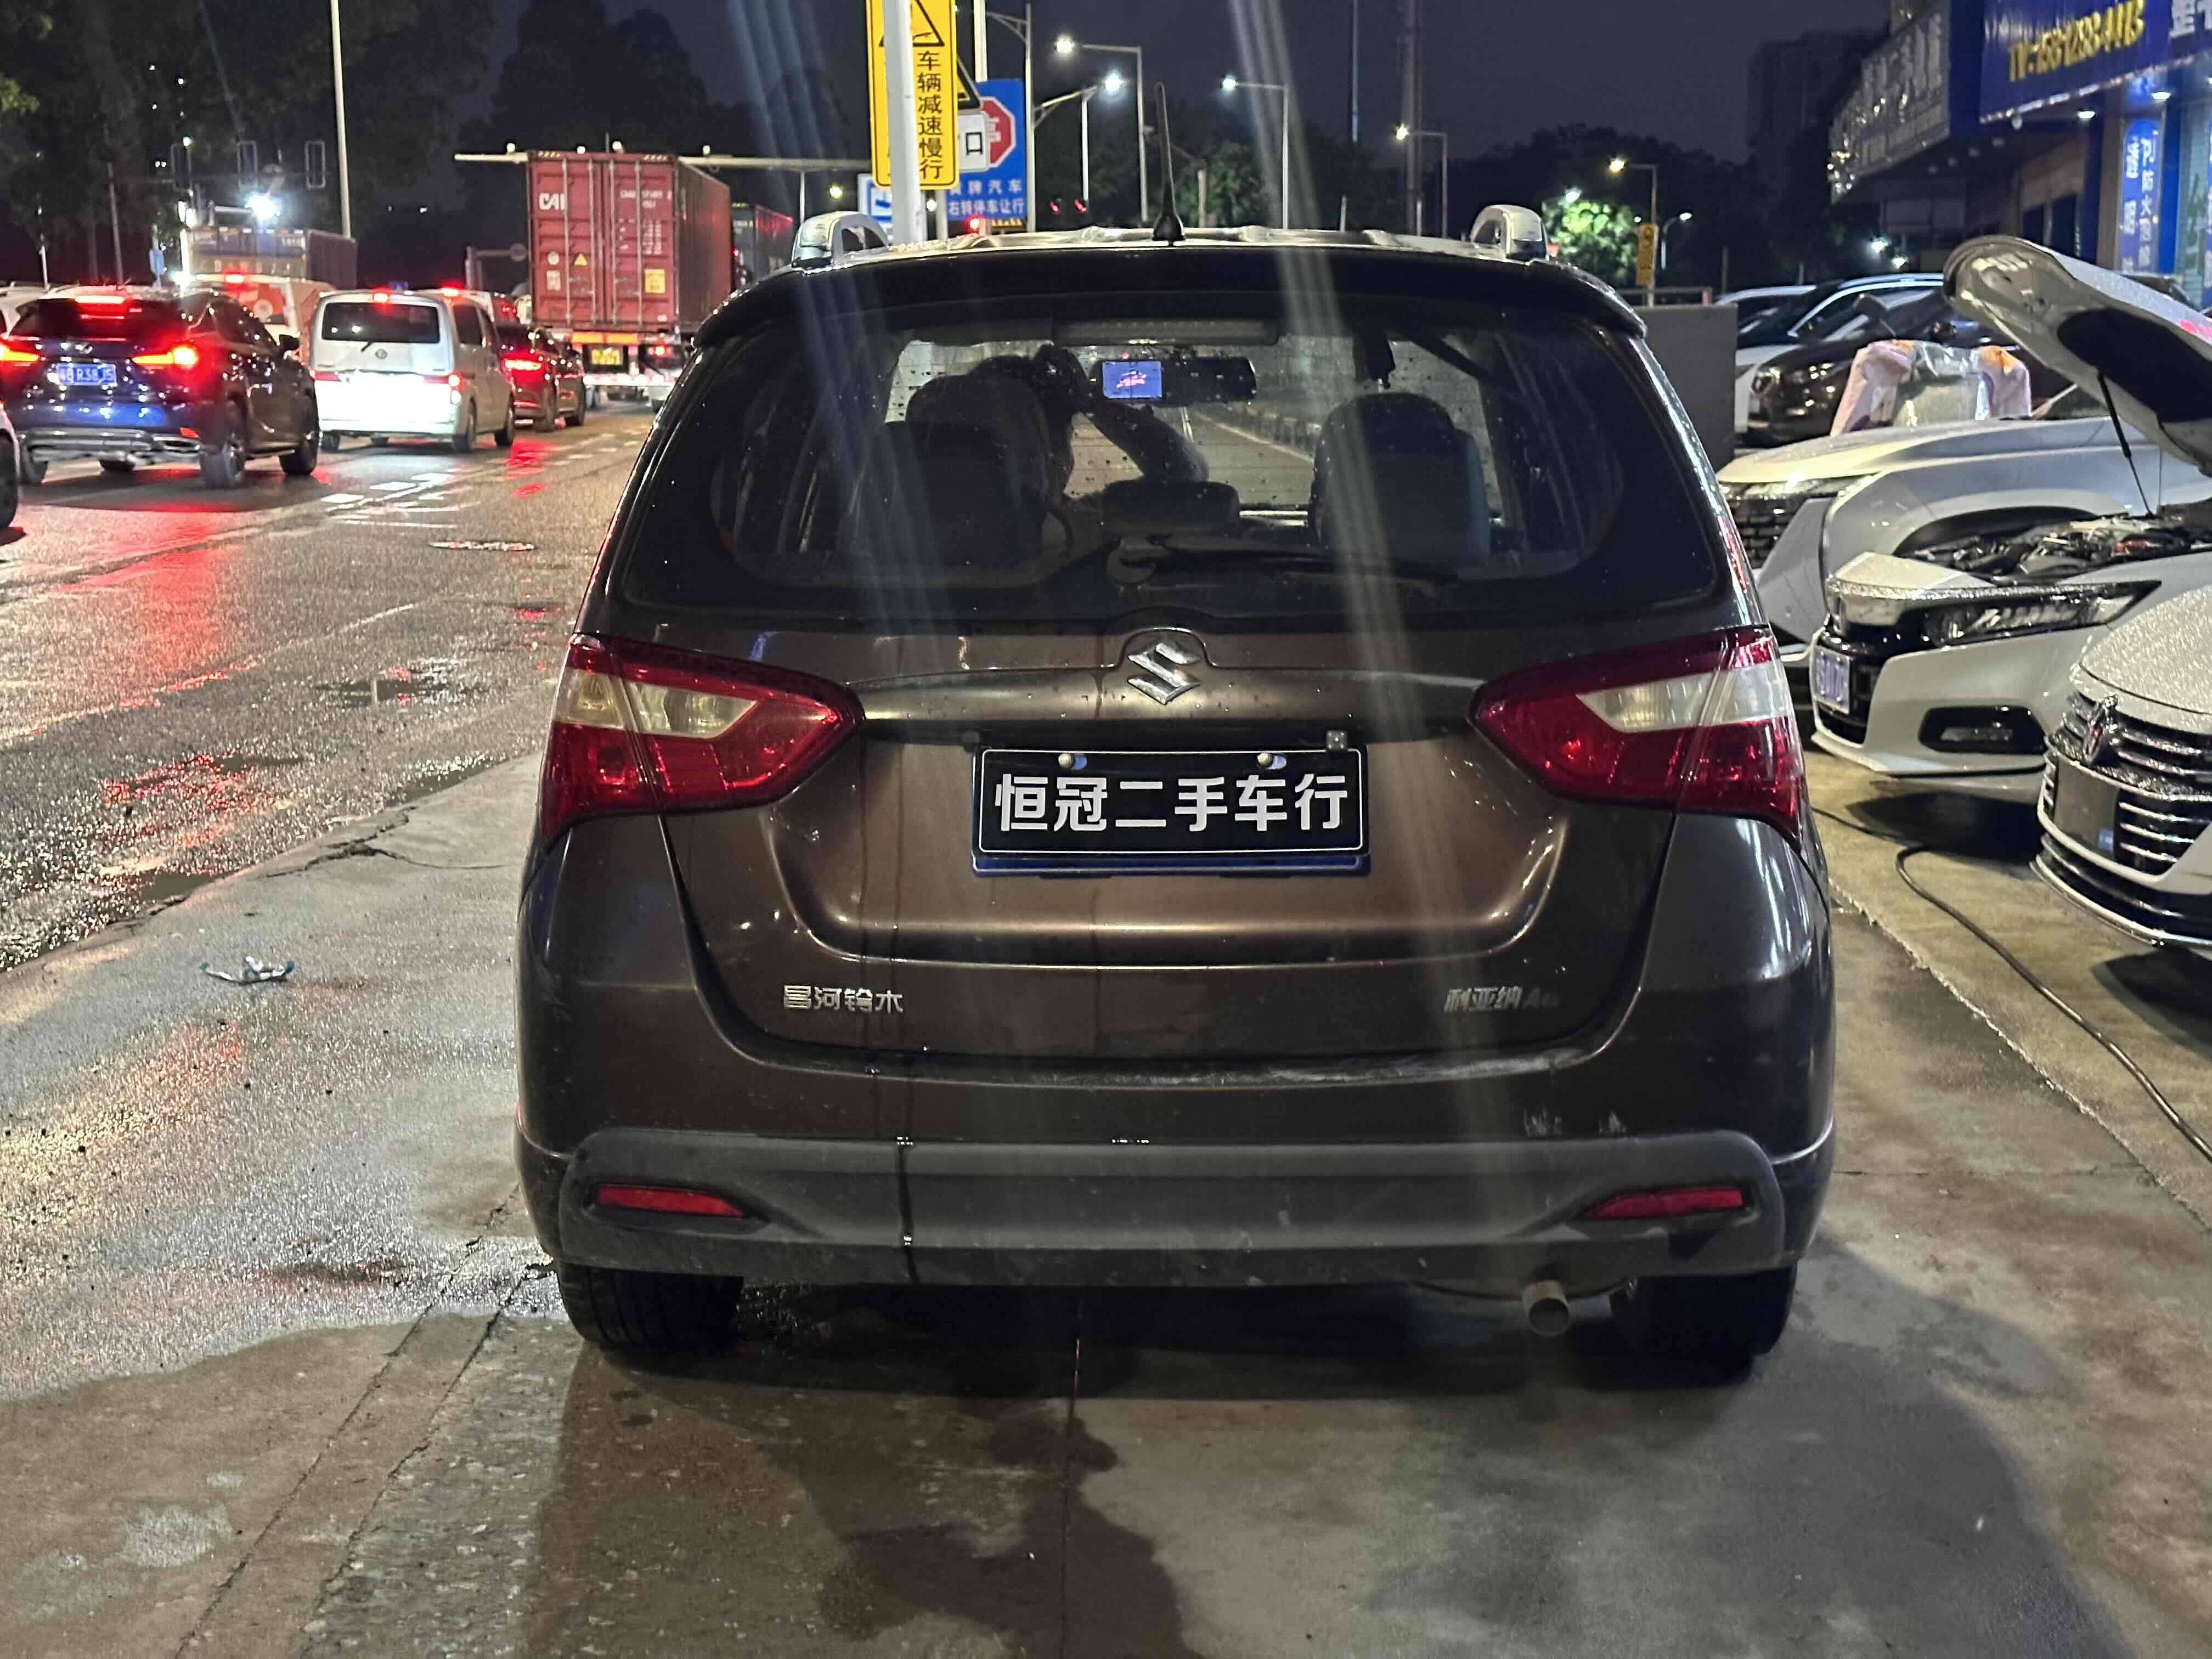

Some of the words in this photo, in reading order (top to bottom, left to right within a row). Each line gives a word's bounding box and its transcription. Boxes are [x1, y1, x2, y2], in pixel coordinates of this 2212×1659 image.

[917, 50, 943, 179] 车辆减速慢行
[995, 774, 1347, 832] 恒冠二手车行
[784, 985, 904, 1013] 昌河铃木
